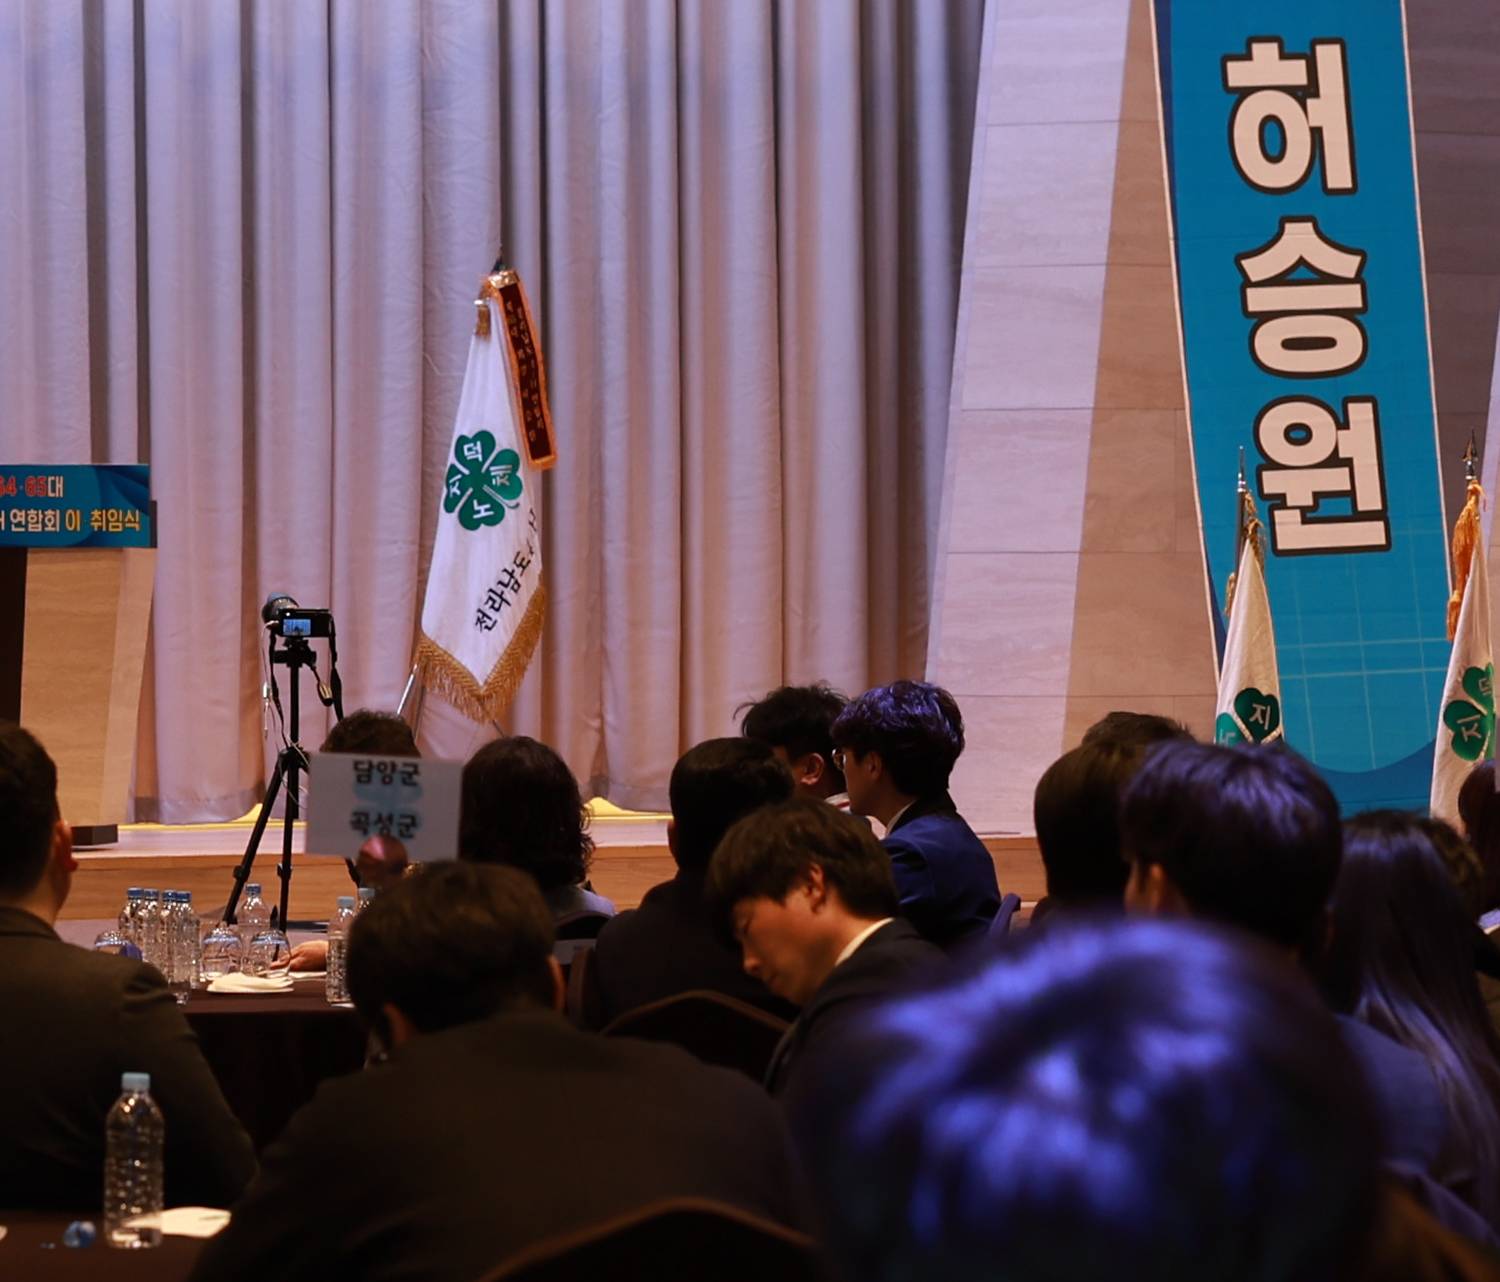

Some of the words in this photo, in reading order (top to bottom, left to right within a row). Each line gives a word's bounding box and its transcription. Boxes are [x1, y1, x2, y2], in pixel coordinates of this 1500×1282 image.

[1221, 34, 1392, 557] 허승원
[463, 440, 482, 462] 덕
[9, 509, 60, 533] 연합회
[1249, 703, 1271, 730] 지
[353, 760, 422, 787] 담양군
